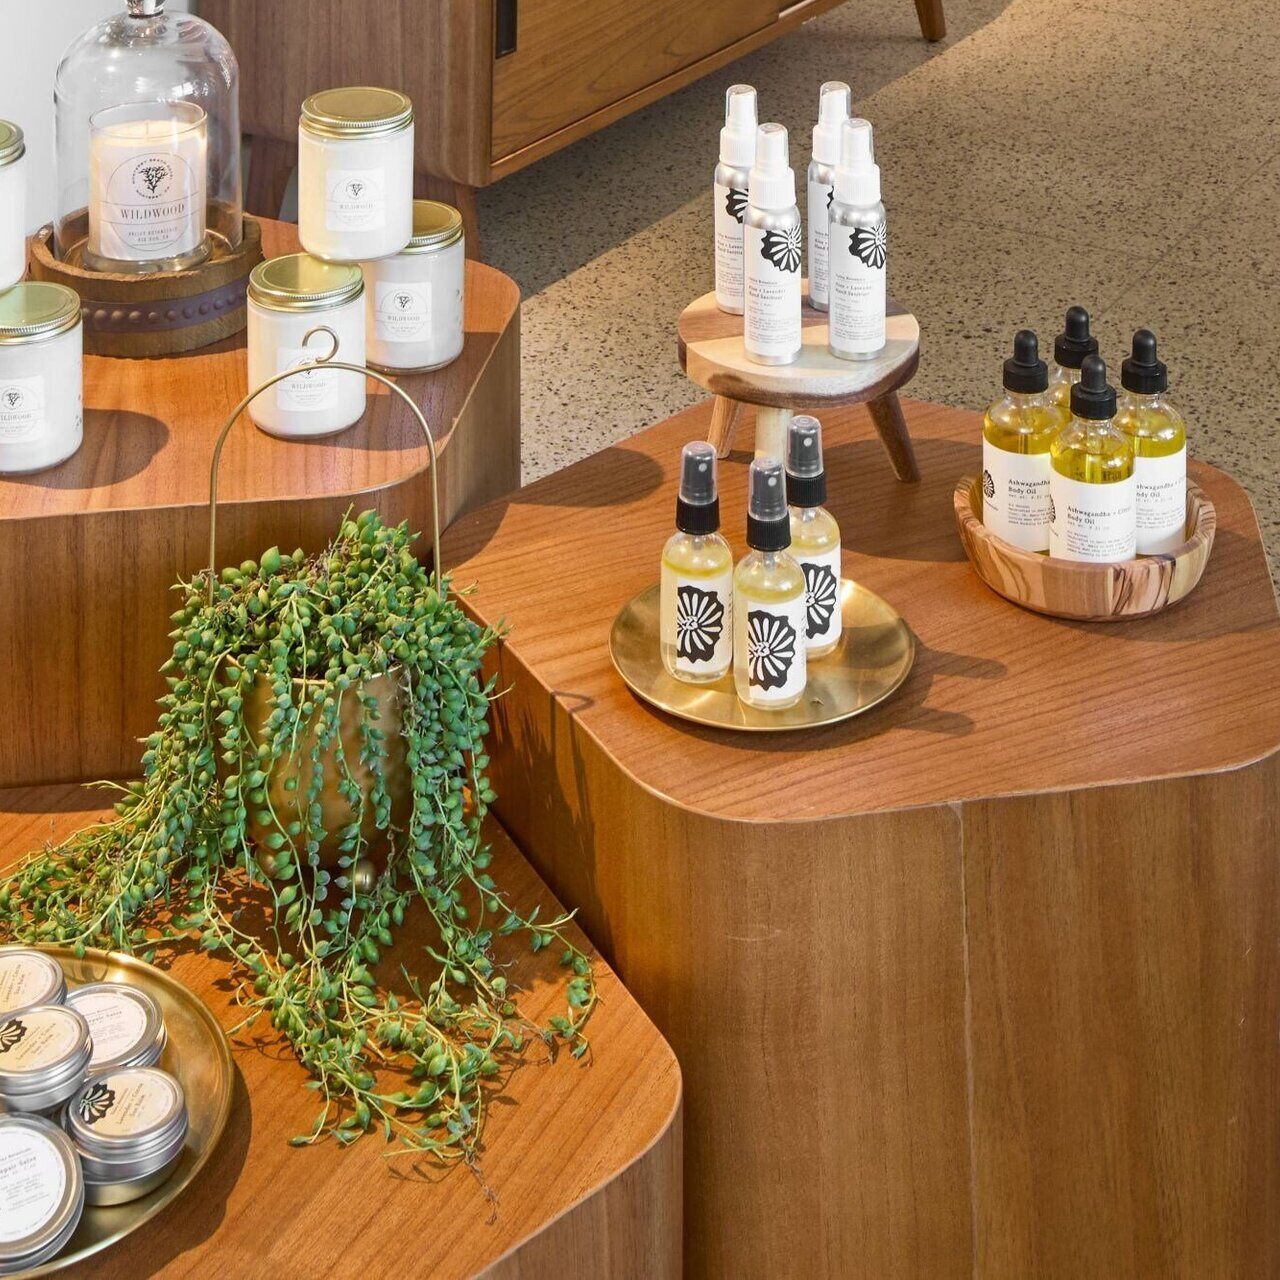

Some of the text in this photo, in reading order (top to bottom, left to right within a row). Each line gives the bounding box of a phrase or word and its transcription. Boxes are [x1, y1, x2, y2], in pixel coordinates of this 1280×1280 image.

[120, 202, 185, 220] WILDWOOD
[1008, 478, 1050, 488] Ashwagandha
[1136, 483, 1174, 491] shwagandha
[1008, 488, 1024, 496] Body
[1067, 506, 1111, 517] Ashwagandha
[1067, 514, 1084, 524] Body
